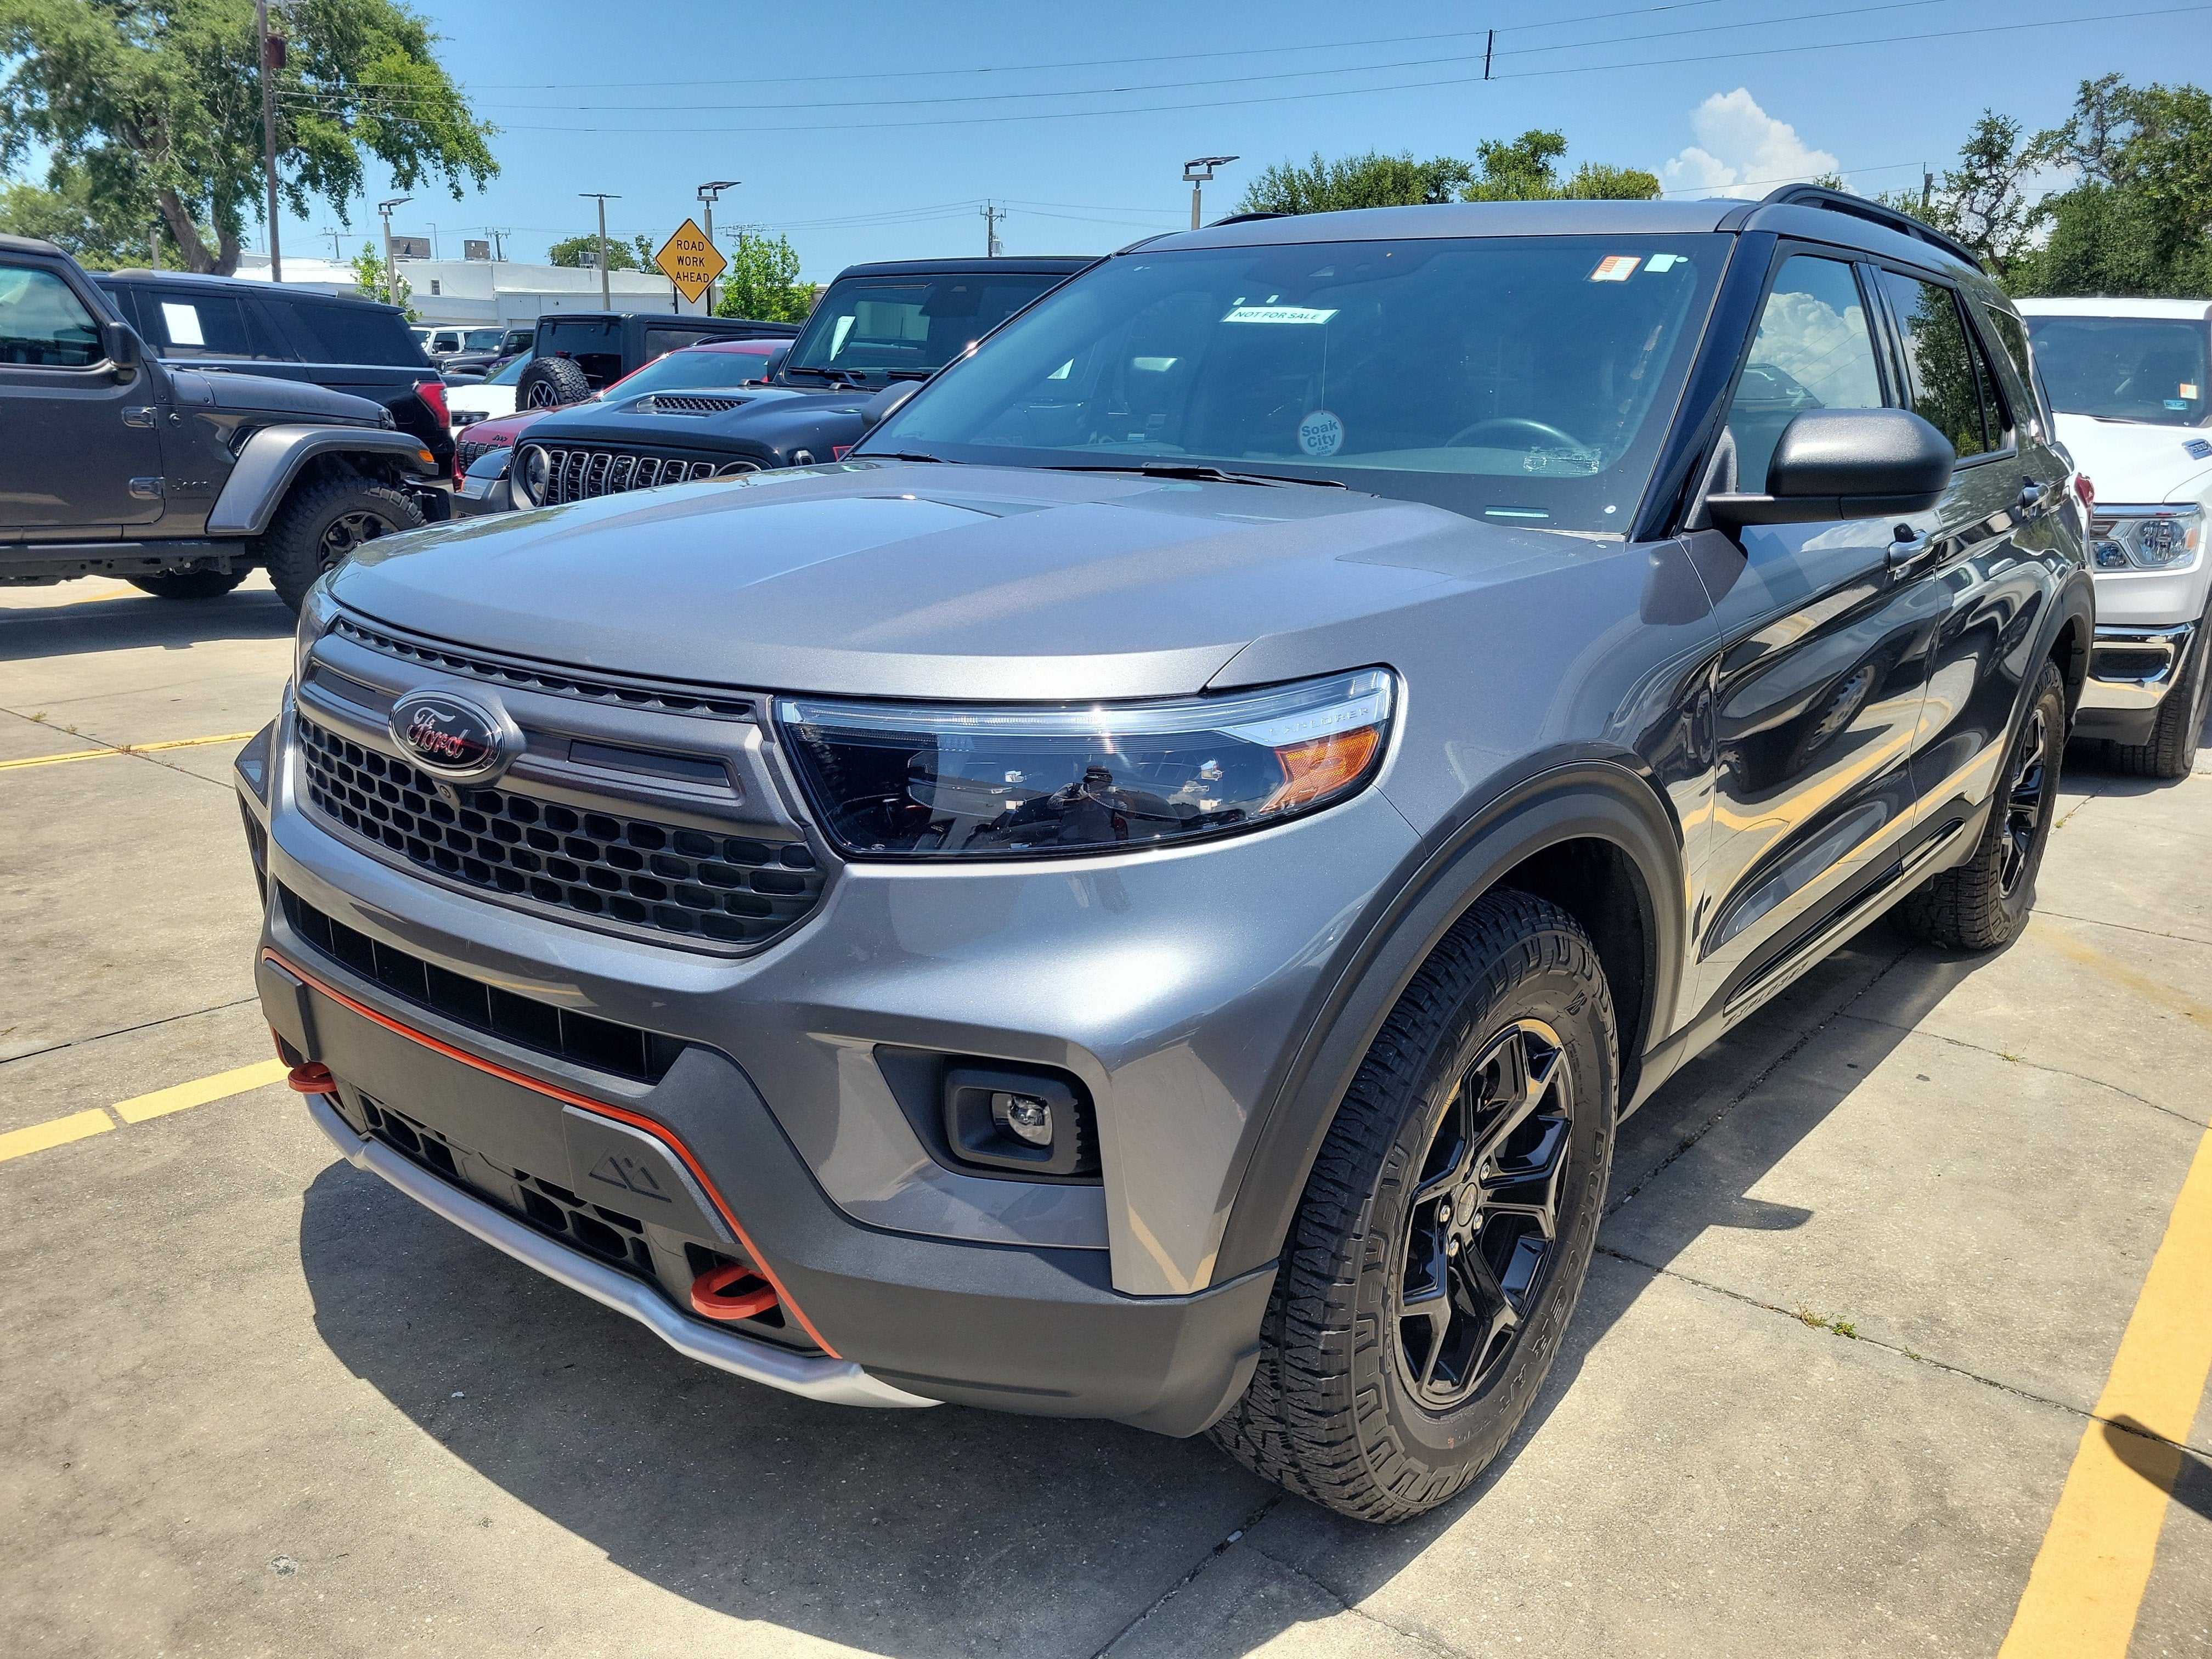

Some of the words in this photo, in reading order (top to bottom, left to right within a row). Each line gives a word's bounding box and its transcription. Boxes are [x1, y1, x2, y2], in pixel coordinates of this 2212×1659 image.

[676, 240, 704, 251] ROAD
[676, 256, 705, 267] WORK
[675, 271, 709, 283] AHEAD
[1301, 420, 1339, 437] Soak
[1307, 434, 1336, 448] City
[1268, 707, 1369, 736] EXPLORER
[406, 707, 471, 759] Ford
